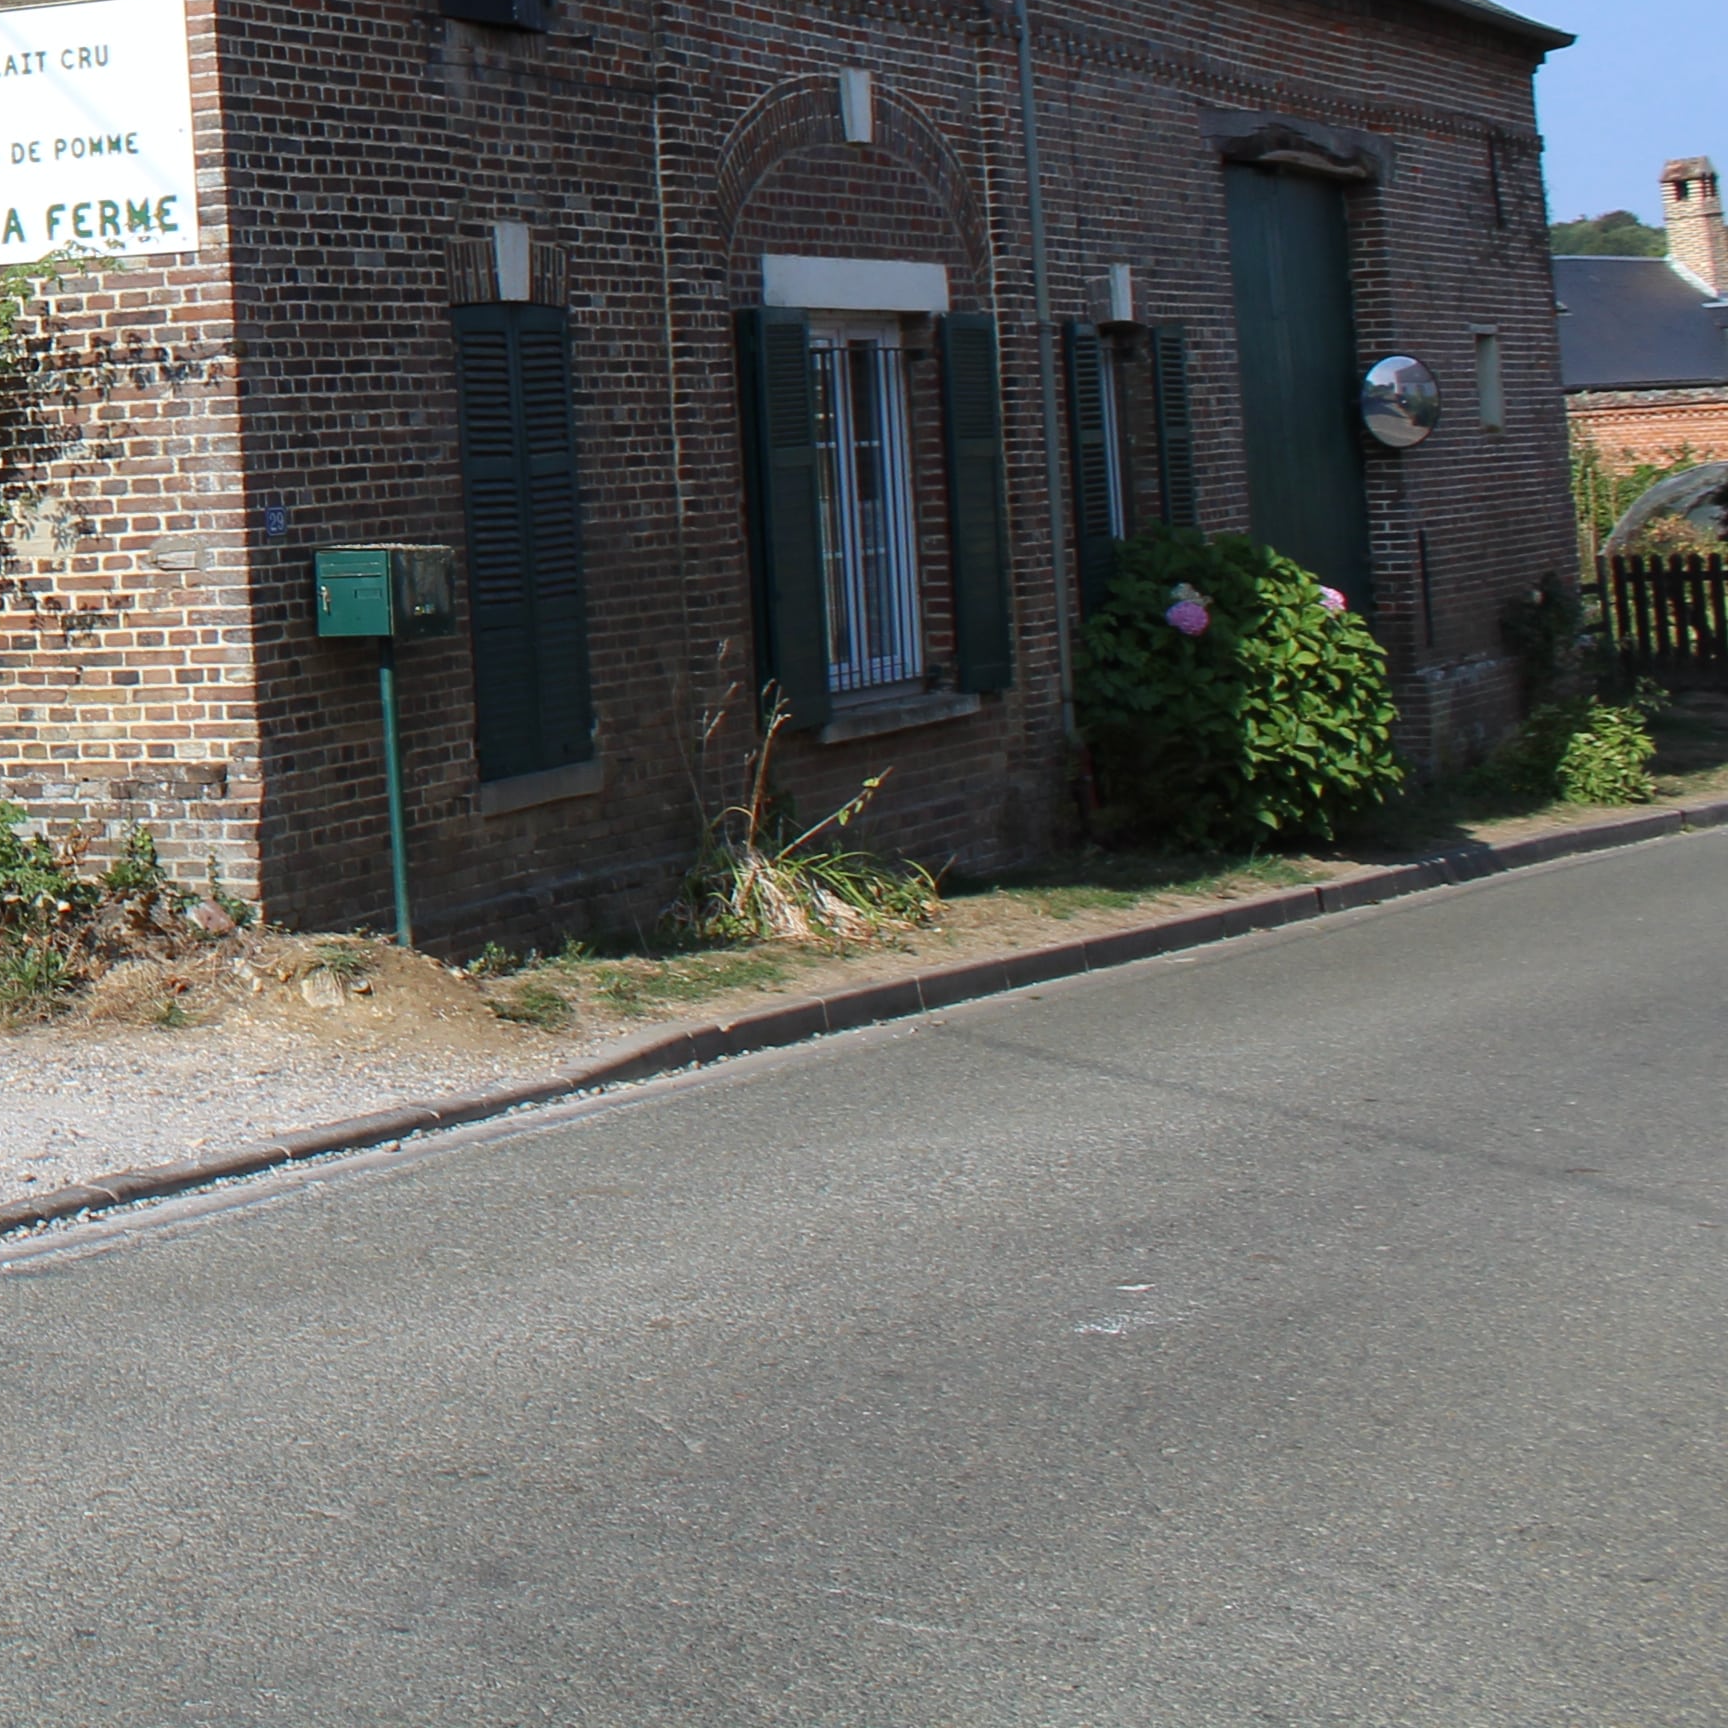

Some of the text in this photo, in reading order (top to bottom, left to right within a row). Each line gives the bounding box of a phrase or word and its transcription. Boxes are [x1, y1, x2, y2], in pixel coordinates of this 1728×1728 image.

[60, 44, 109, 70] CRU
[11, 141, 41, 164] DE
[54, 132, 139, 161] POMME
[46, 194, 178, 241] FERME
[268, 511, 285, 532] 29
